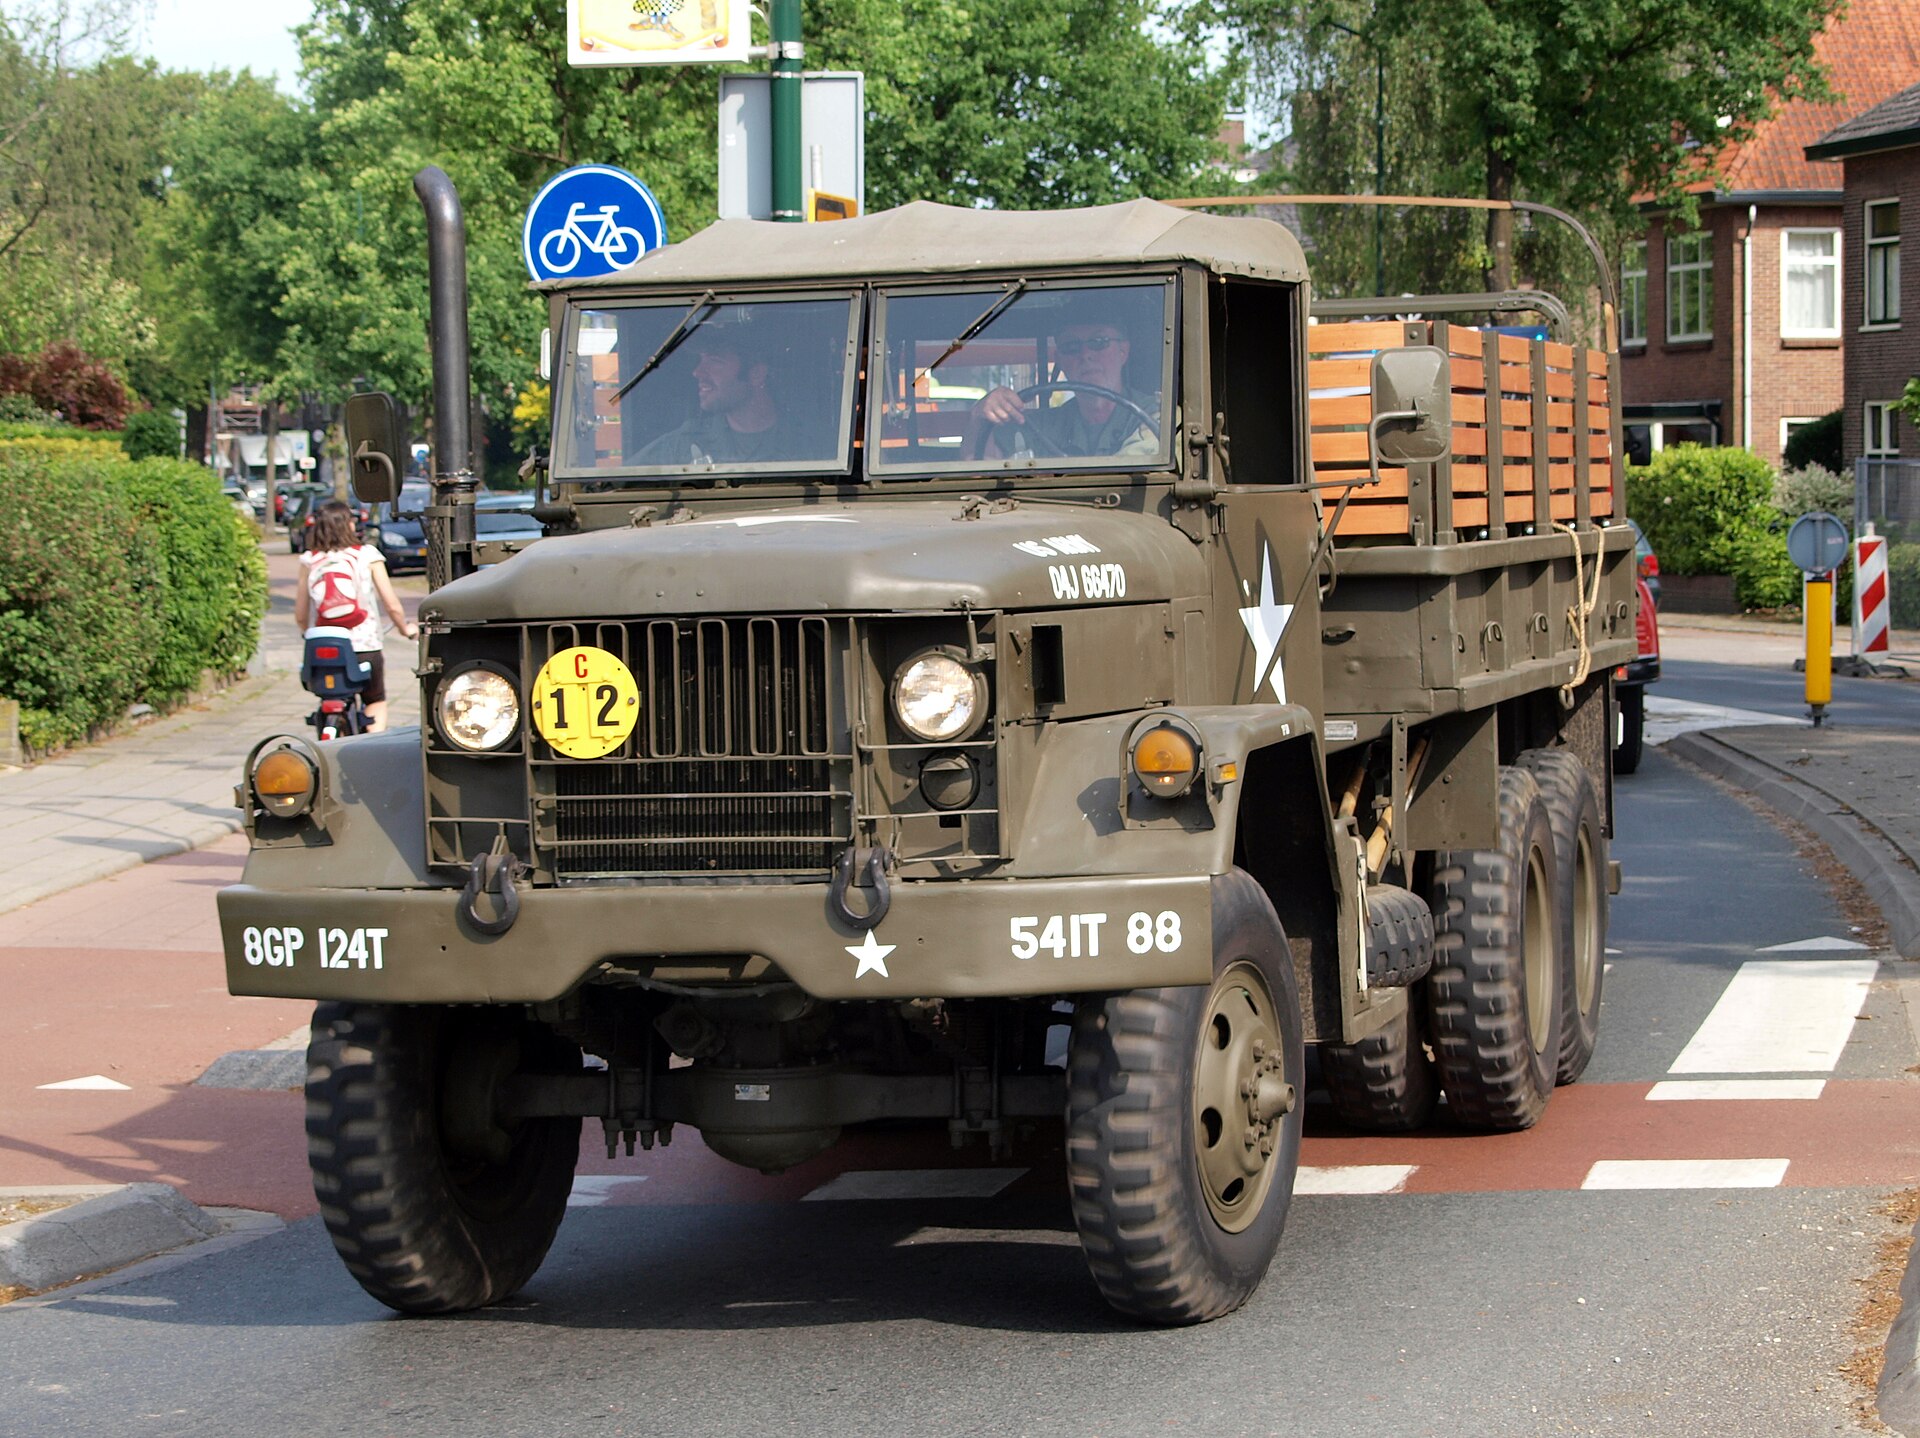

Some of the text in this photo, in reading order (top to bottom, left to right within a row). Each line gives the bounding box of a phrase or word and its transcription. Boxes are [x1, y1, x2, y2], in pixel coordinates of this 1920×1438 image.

[1080, 563, 1126, 599] 66470
[574, 653, 588, 679] C
[243, 926, 304, 967] 8GP
[1126, 910, 1183, 955] 88
